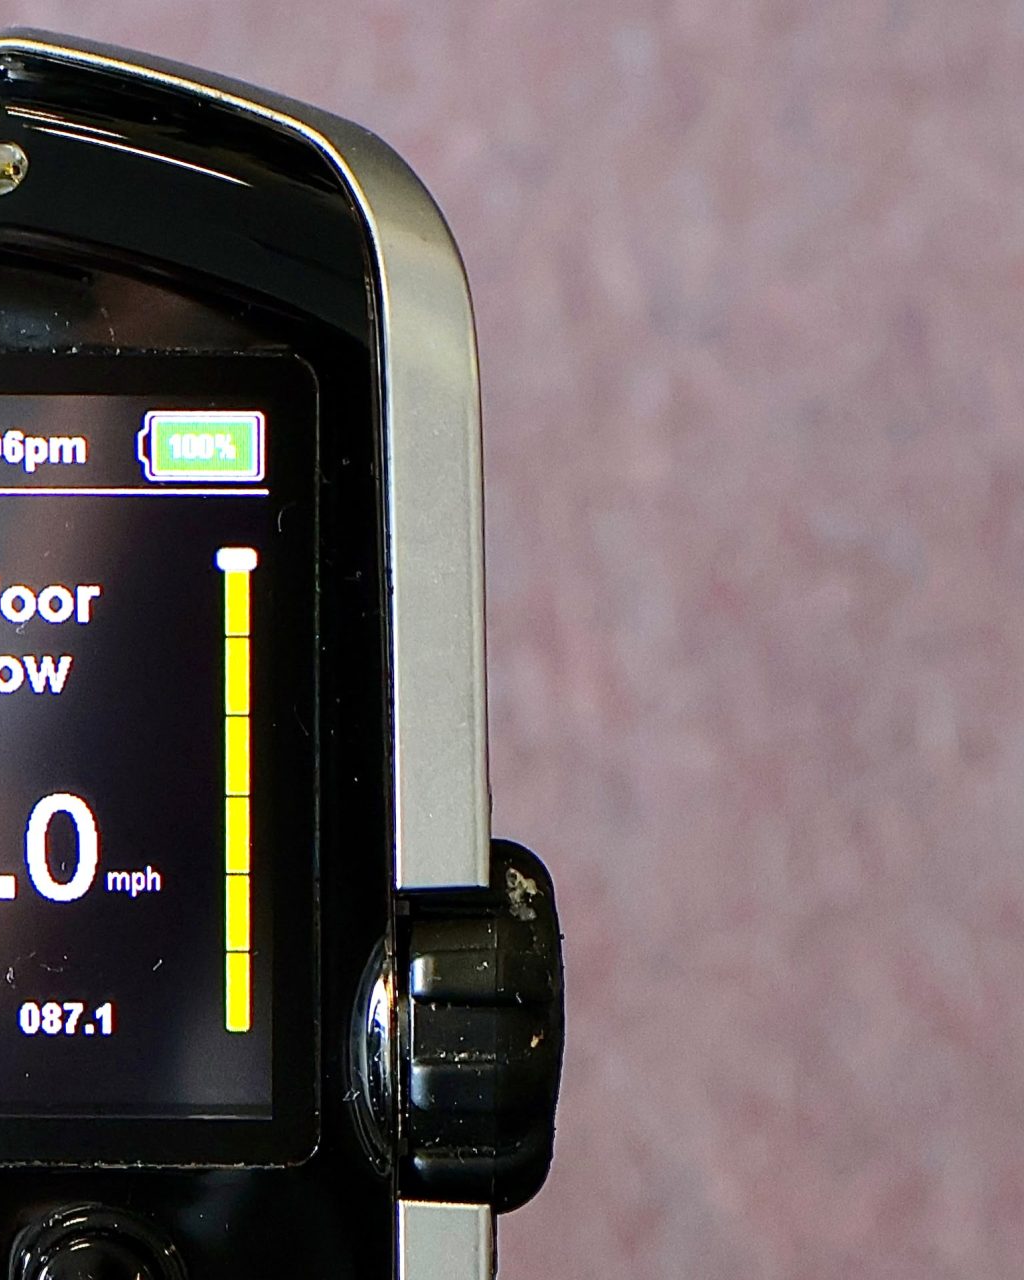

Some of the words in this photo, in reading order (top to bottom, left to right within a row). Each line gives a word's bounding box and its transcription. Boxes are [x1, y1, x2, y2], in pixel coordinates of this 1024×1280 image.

[168, 432, 237, 460] 100%
[107, 865, 161, 897] mph
[18, 1002, 114, 1034] 087.1
